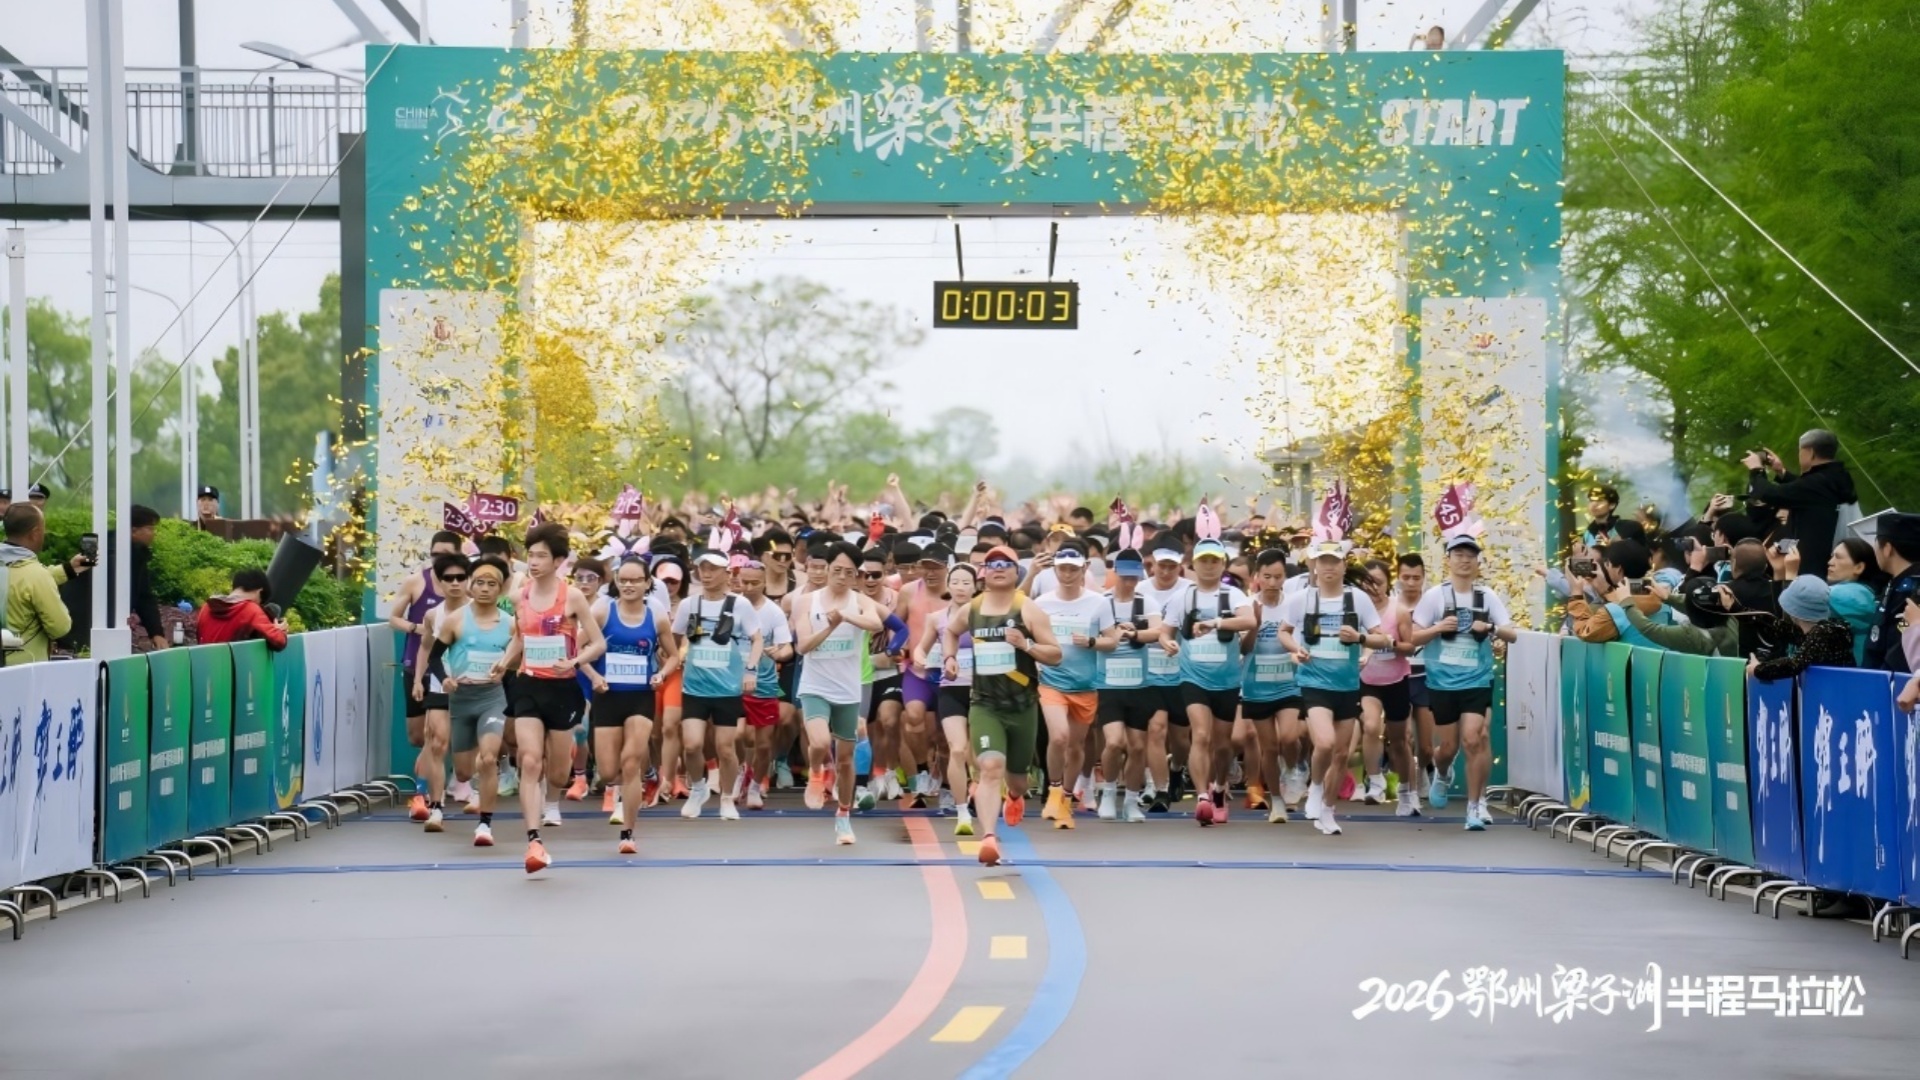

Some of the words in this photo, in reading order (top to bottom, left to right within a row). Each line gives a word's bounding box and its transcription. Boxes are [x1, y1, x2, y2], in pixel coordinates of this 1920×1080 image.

[395, 106, 439, 119] CHINA
[1378, 97, 1528, 147] START
[942, 289, 1070, 321] 0:00:03
[478, 498, 517, 517] 2:30
